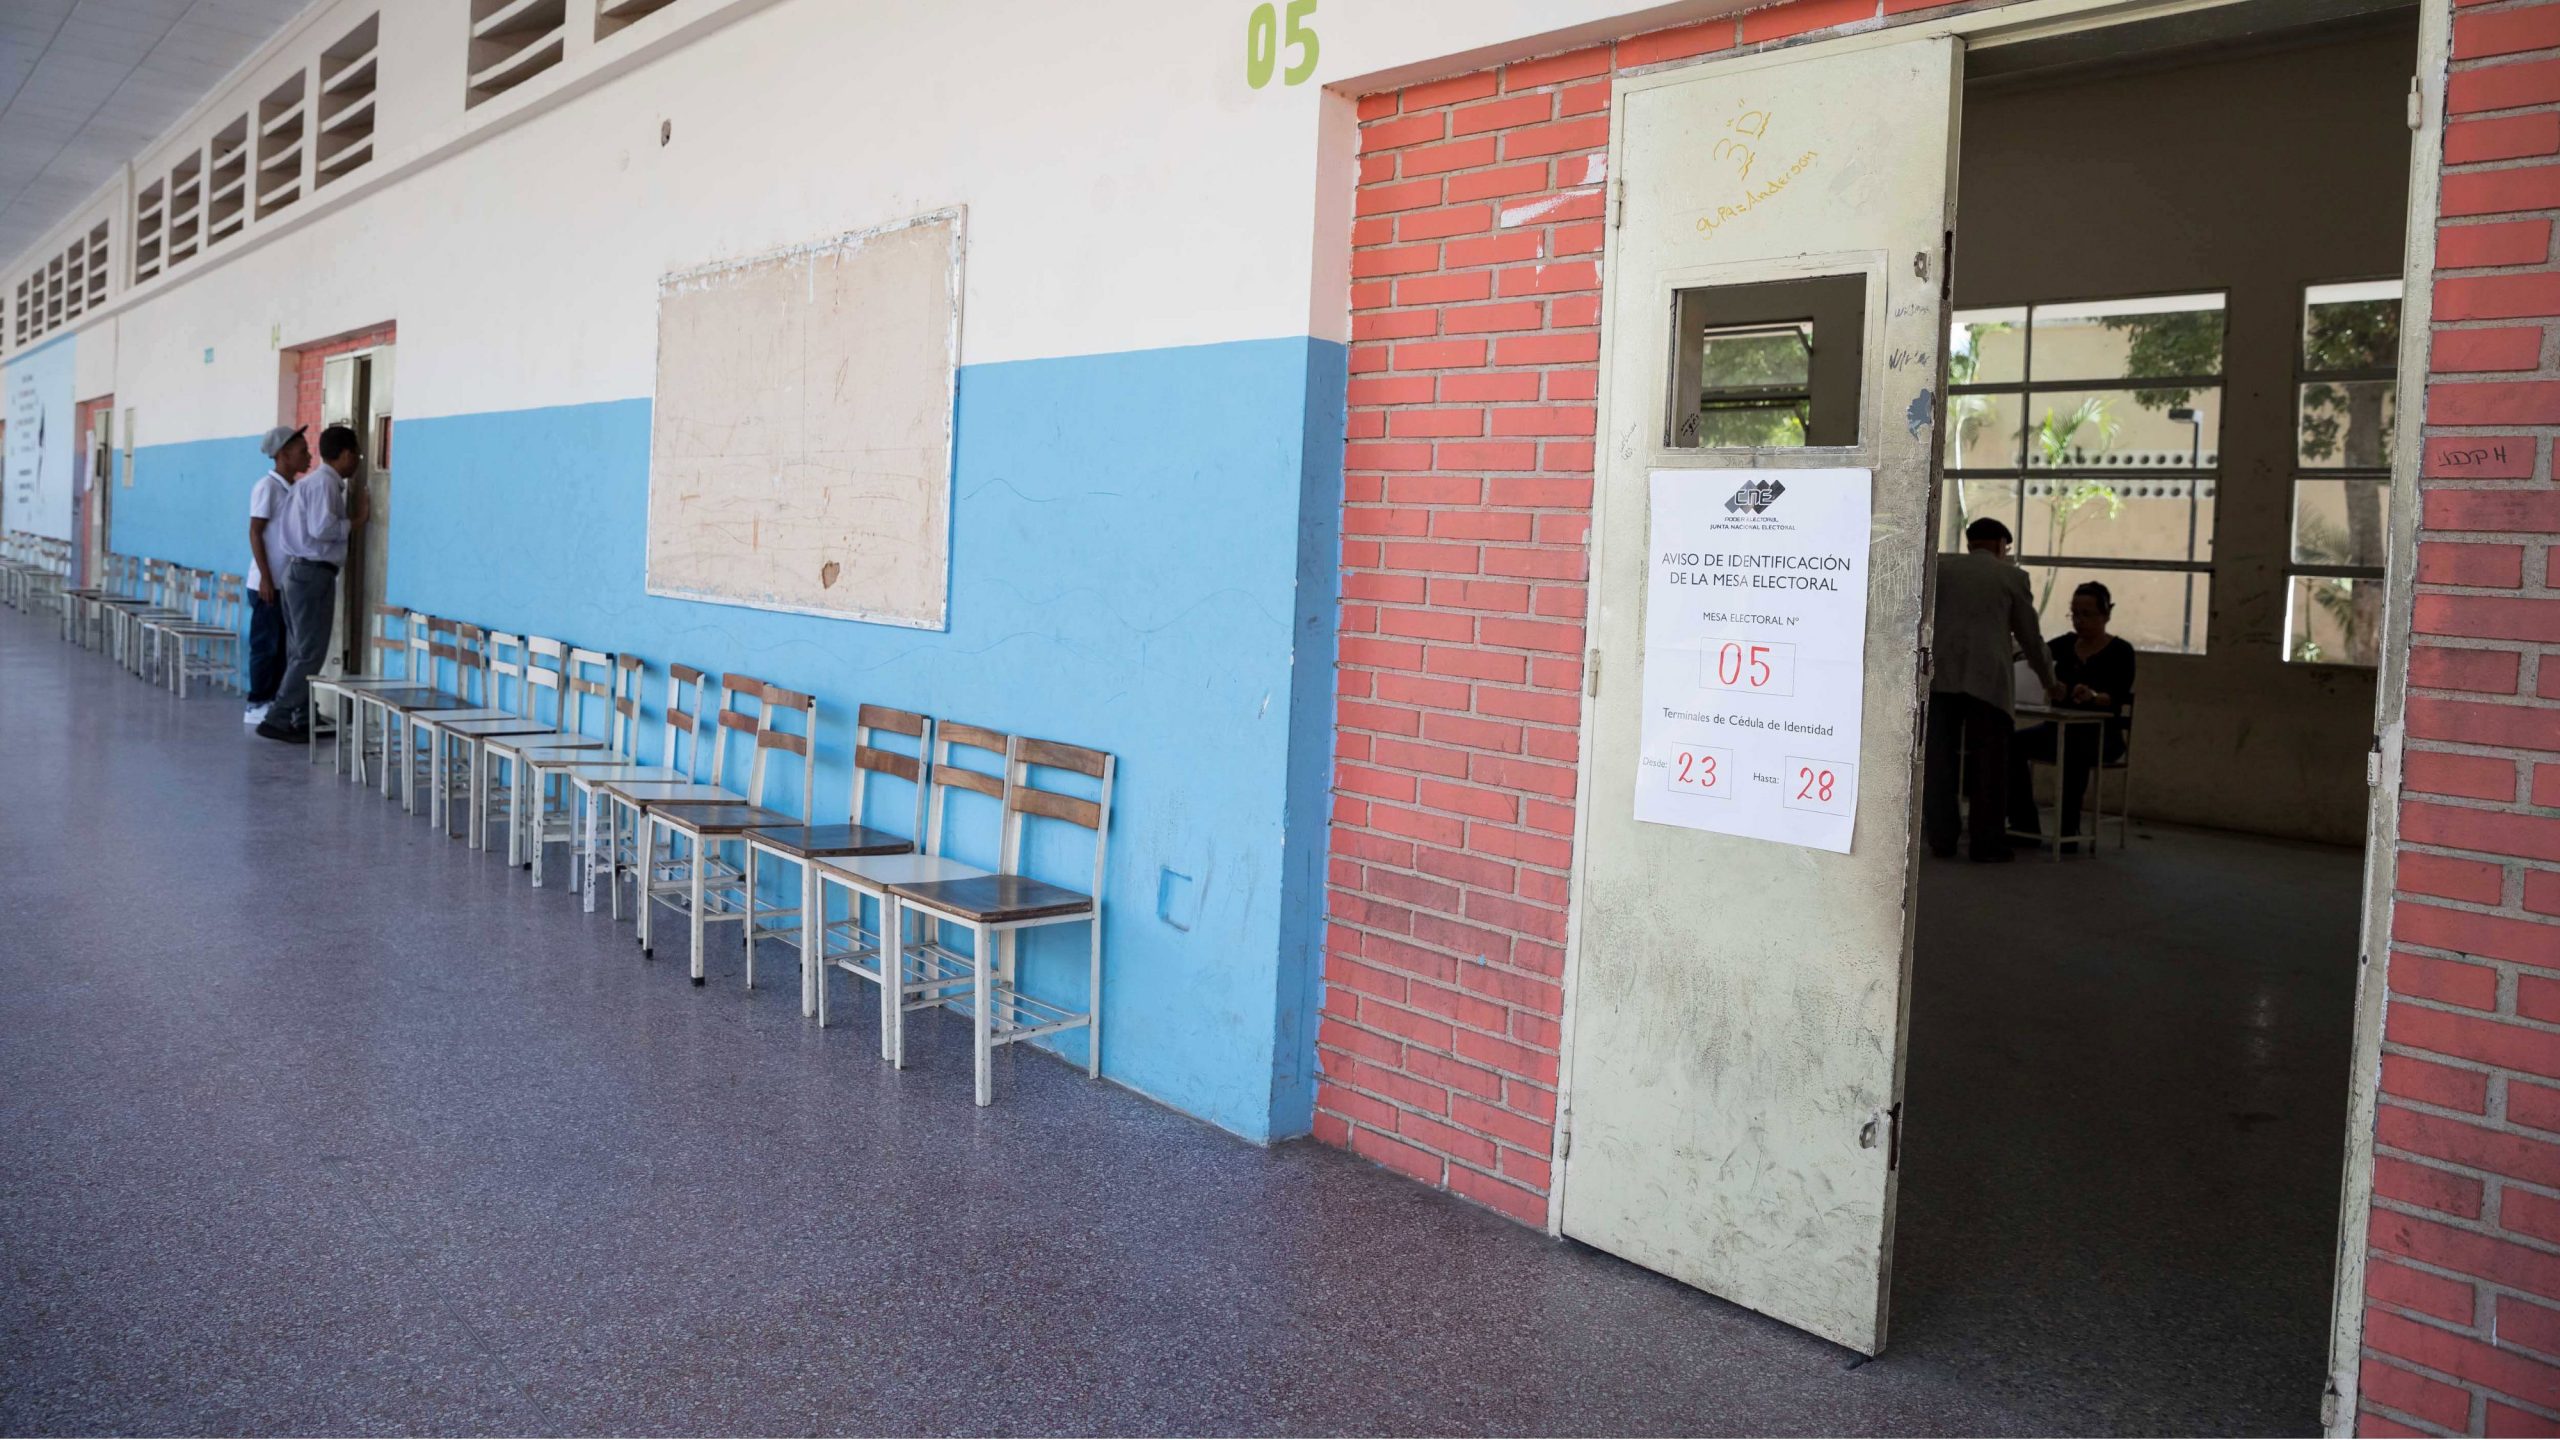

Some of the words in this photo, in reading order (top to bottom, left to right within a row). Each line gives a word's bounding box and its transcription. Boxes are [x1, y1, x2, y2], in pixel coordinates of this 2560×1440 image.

[1247, 0, 1320, 90] 05
[1734, 488, 1774, 506] CNE
[1661, 553, 1699, 566] AVISO
[1704, 554, 1723, 567] DE
[1728, 553, 1851, 571] IDENTIFICACIÓN
[1670, 571, 1687, 585] DE
[1691, 573, 1708, 586] LA
[1713, 573, 1748, 587] MESA
[1753, 576, 1838, 591] ELECTORAL
[1703, 612, 1727, 622] MESA
[1730, 613, 1783, 626] ELECTORAL
[1718, 642, 1771, 687] 05
[1663, 707, 1710, 723] Terminales
[1713, 713, 1726, 725] de
[1729, 714, 1764, 729] Cédula
[1767, 719, 1781, 731] de
[1784, 720, 1833, 736] Identidad
[1642, 756, 1668, 769] Desde:
[1678, 751, 1717, 787] 23
[1753, 772, 1780, 784] Hasta:
[1796, 767, 1835, 802] 28
